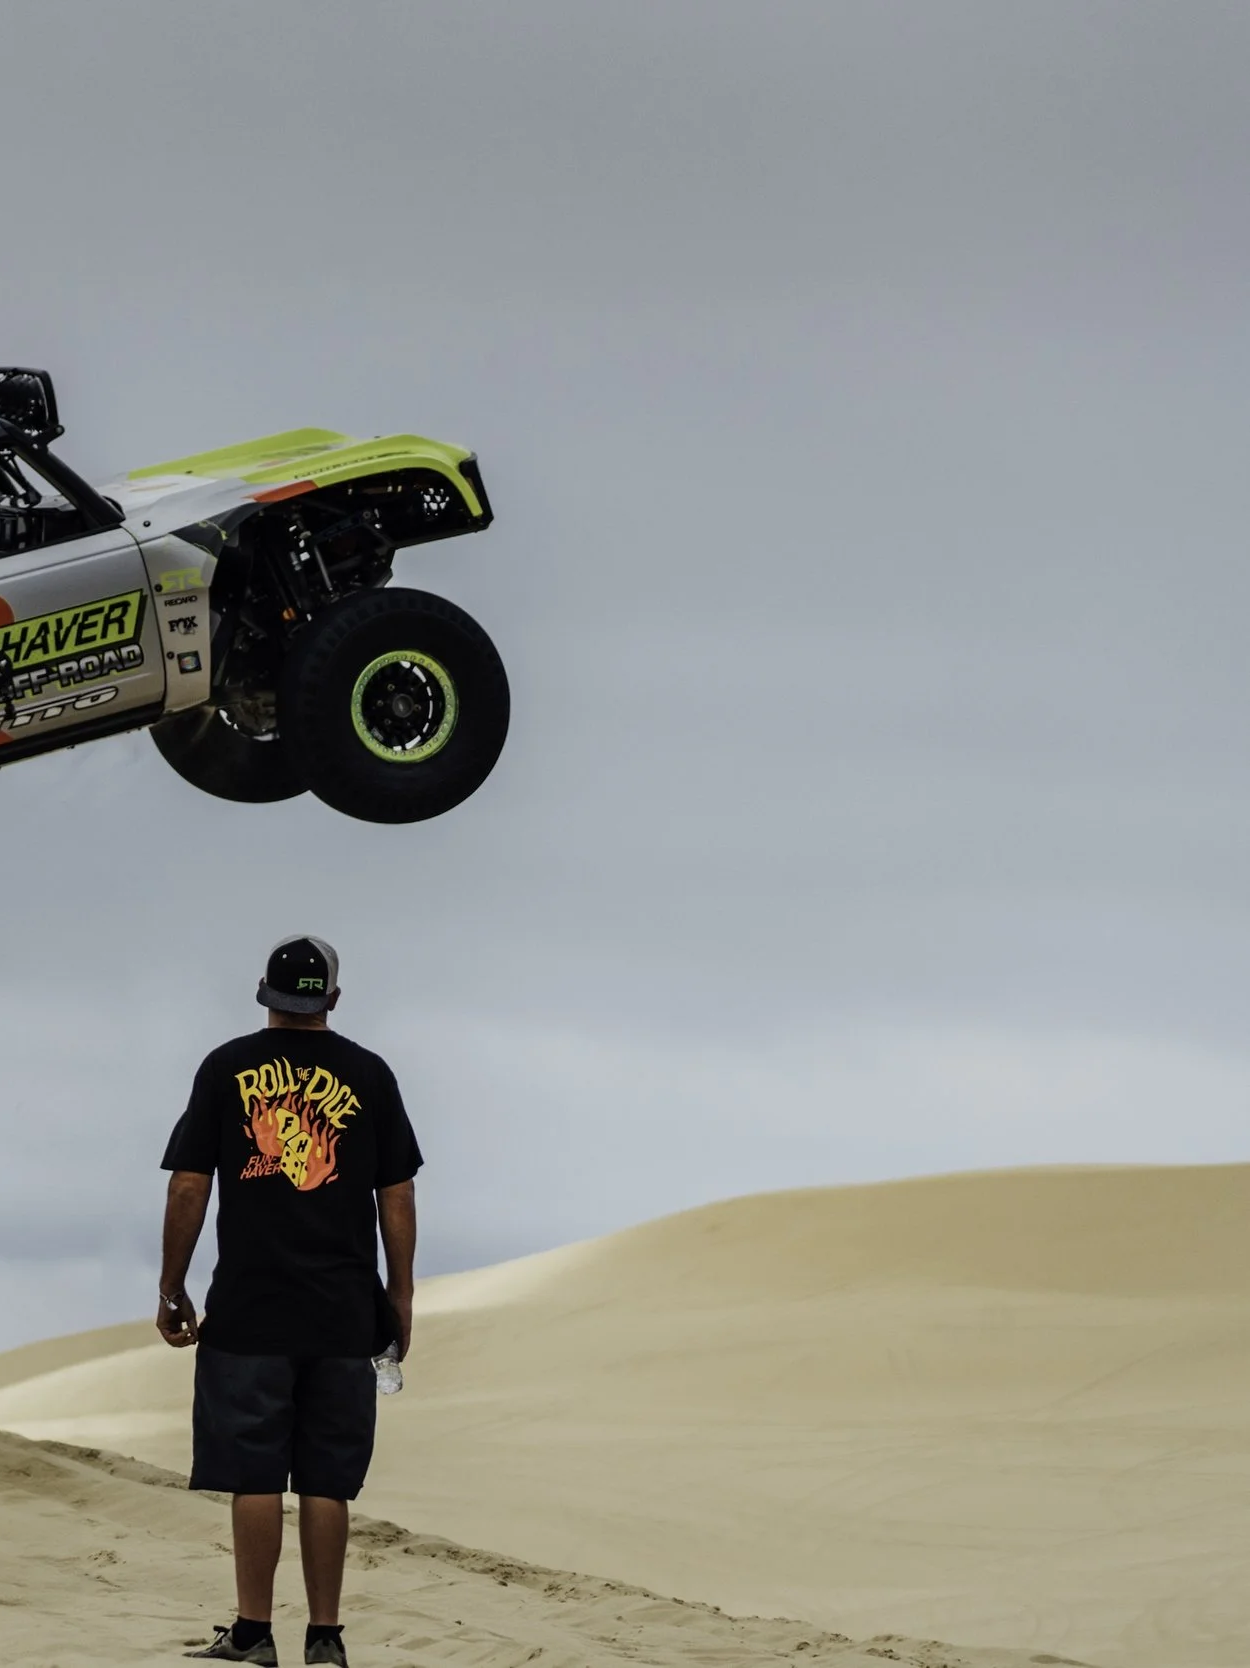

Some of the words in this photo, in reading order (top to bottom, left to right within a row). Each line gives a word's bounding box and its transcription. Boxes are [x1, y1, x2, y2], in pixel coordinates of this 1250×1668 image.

[164, 595, 198, 607] RECARO
[0, 599, 131, 663] HAVER
[168, 616, 198, 633] FOX
[295, 1067, 312, 1081] THE
[234, 1056, 302, 1118] ROLL
[303, 1065, 362, 1129] DICE
[240, 1163, 281, 1180] HAVER
